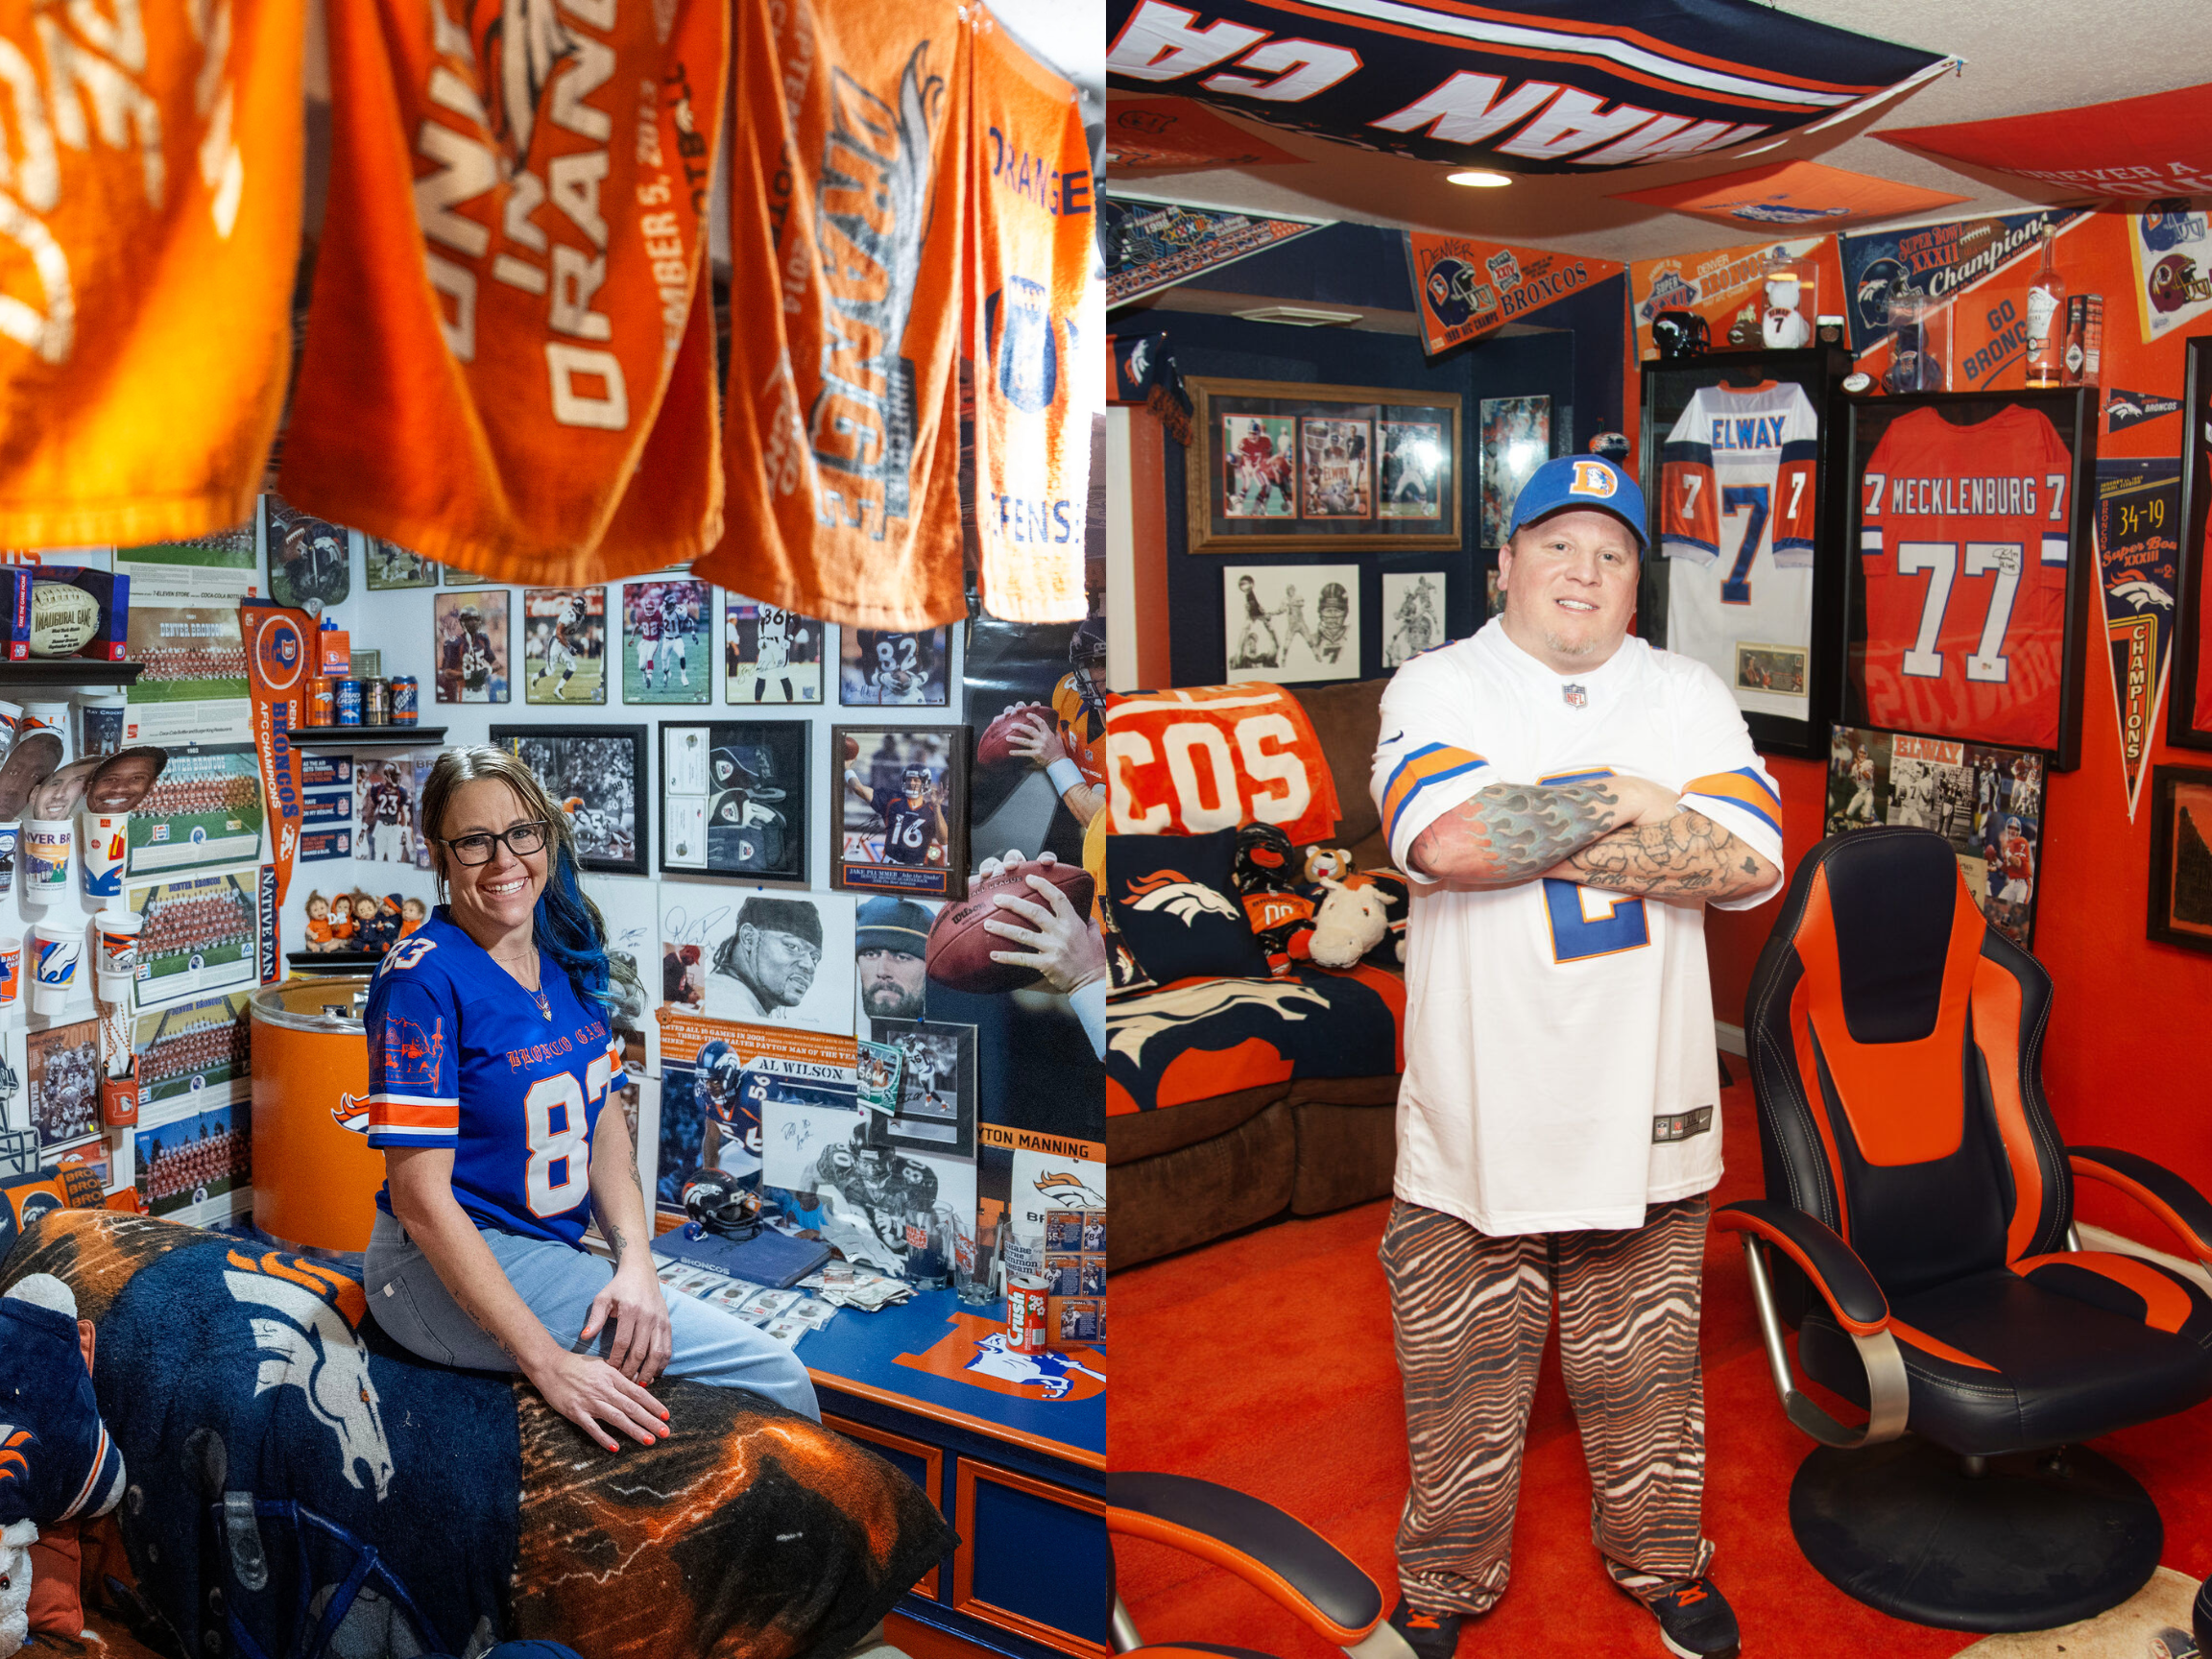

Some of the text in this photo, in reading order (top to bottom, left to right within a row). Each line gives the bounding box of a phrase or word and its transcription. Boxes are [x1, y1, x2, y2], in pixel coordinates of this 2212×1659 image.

[1366, 70, 1774, 165] MAN
[2167, 161, 2200, 176] A
[1142, 217, 1169, 235] 1998
[1166, 218, 1206, 241] XXXII
[1156, 241, 1209, 270] BOWL
[1898, 222, 1966, 262] SUPER BOWL
[1929, 211, 2049, 298] Champions
[1419, 239, 1475, 278] DENVER
[1494, 262, 1517, 280] XXIV
[1696, 253, 1730, 276] DENVER
[1910, 242, 1961, 276] XXXII
[1500, 262, 1588, 317] BRONCOS
[1655, 276, 1679, 294] SUPER
[1698, 252, 1769, 301] BRONCOS
[1462, 324, 1476, 337] AFC
[1476, 310, 1500, 333] CHAMPS
[1773, 318, 1785, 334] 7
[1986, 299, 2016, 332] GO
[2144, 401, 2177, 413] BRONCOS
[1711, 416, 1787, 451] ELWAY
[1681, 474, 1703, 519] 7
[1786, 471, 1807, 519] 7
[1863, 473, 1887, 517] 7
[1890, 476, 2038, 517] MECKLENBURG
[2046, 473, 2066, 521] 7
[2101, 499, 2109, 551] BRONCOS
[2119, 498, 2165, 537] 34-19
[1719, 483, 1772, 606] 7
[2102, 541, 2146, 568] Super
[2124, 549, 2160, 567] XXXIII
[2163, 564, 2174, 579] 2
[35, 608, 91, 633] INAUGURAL GAME
[1897, 541, 2025, 685] 77
[159, 622, 190, 637] DENVER
[876, 637, 918, 672] 82
[1323, 646, 1342, 664] 7
[1566, 693, 1586, 705] NFL
[2126, 625, 2147, 759] CHAMPIONS
[193, 756, 226, 771] BRONCOS
[260, 701, 281, 808] AFC CHAMPIONS
[273, 702, 300, 818] BRONCOS
[1893, 735, 1962, 765] ELWAY
[1106, 712, 1310, 835] COS
[378, 795, 398, 815] 23
[607, 801, 619, 811] 60
[1909, 785, 1917, 800] 7
[891, 813, 926, 849] 16
[2020, 844, 2026, 854] 7
[168, 877, 222, 893] DENVER BRONCOS
[988, 876, 1022, 891] LEAGUE
[263, 871, 275, 976] NATIVE FAN
[951, 902, 986, 925] Wilson
[379, 937, 438, 978] 83
[172, 997, 223, 1016] DENVER BRONCOS
[709, 1028, 736, 1038] GAMES
[506, 1037, 573, 1074] BRONCO
[724, 1038, 755, 1047] WALTER
[756, 1042, 787, 1052] PAYTON
[789, 1046, 807, 1055] MAN
[820, 1049, 838, 1058] THE
[758, 1058, 780, 1072] AL
[782, 1061, 844, 1081] WILSON
[857, 1066, 872, 1079] 56
[748, 1074, 772, 1101] 56
[1019, 1134, 1089, 1158] MANNING
[680, 1256, 731, 1276] BRONCOS
[1006, 1290, 1026, 1347] Crush
